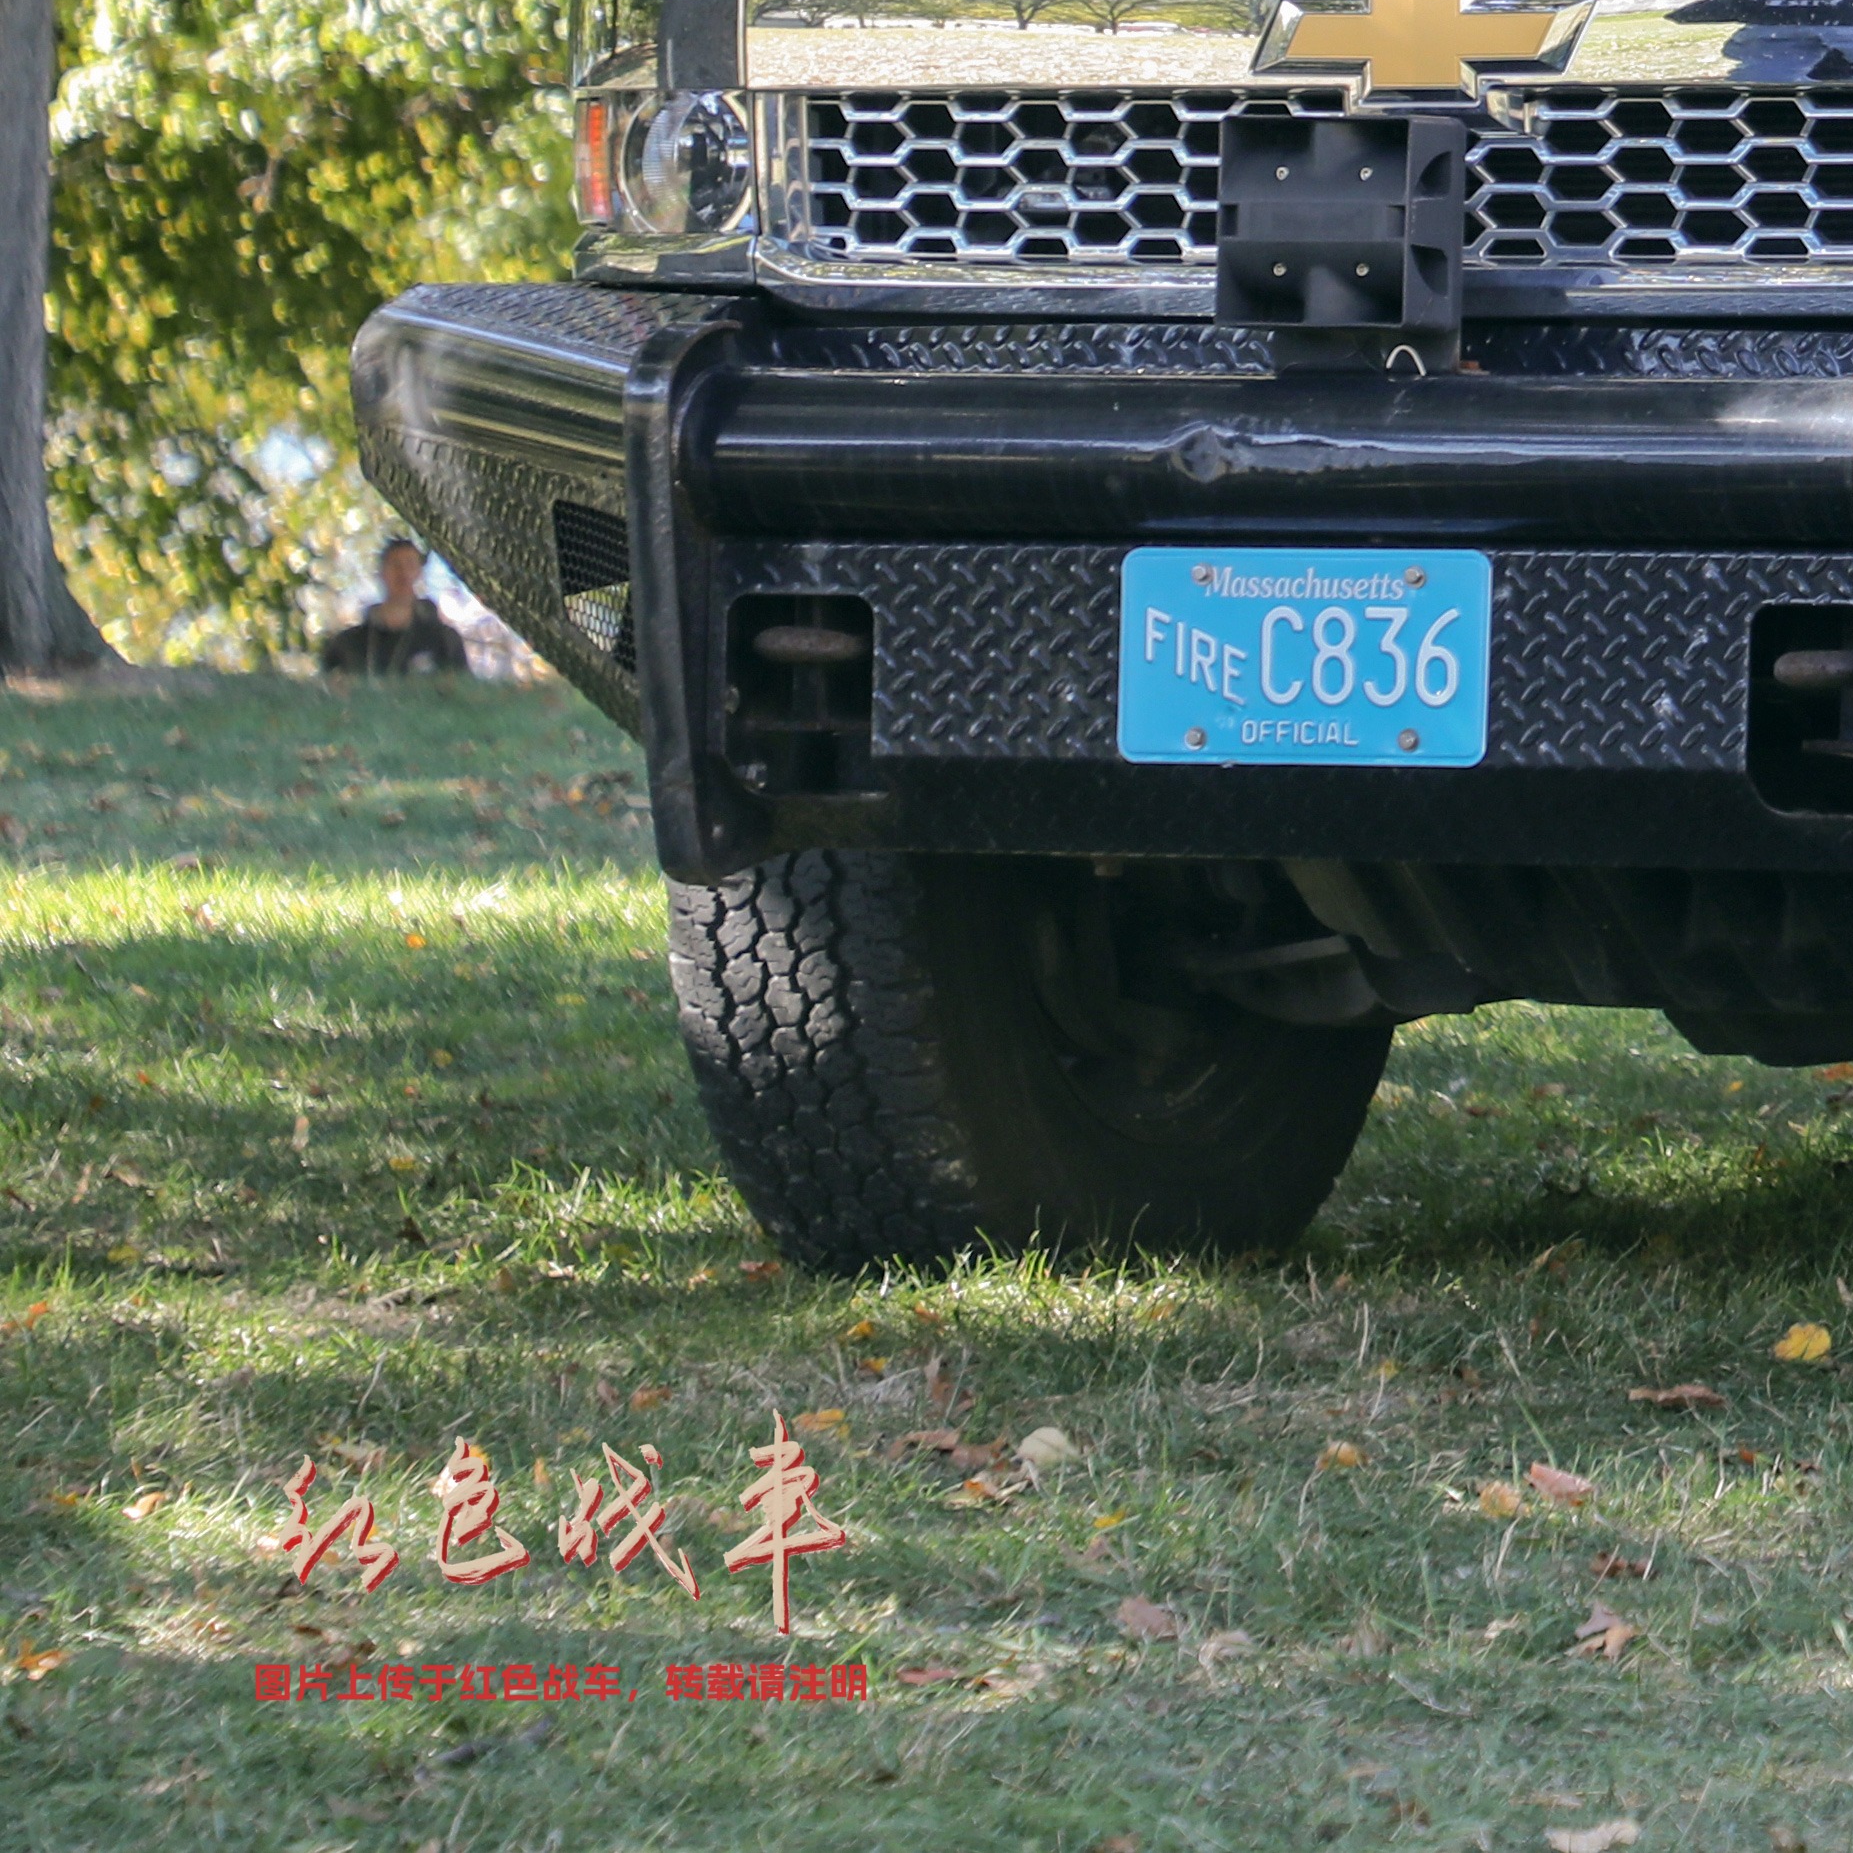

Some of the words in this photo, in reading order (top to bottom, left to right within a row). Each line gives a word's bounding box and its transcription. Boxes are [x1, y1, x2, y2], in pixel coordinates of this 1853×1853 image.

[1204, 566, 1405, 600] Massachusetts
[1145, 607, 1248, 705] FIRE
[1260, 605, 1461, 707] C836
[1241, 719, 1359, 746] OFFICIAL
